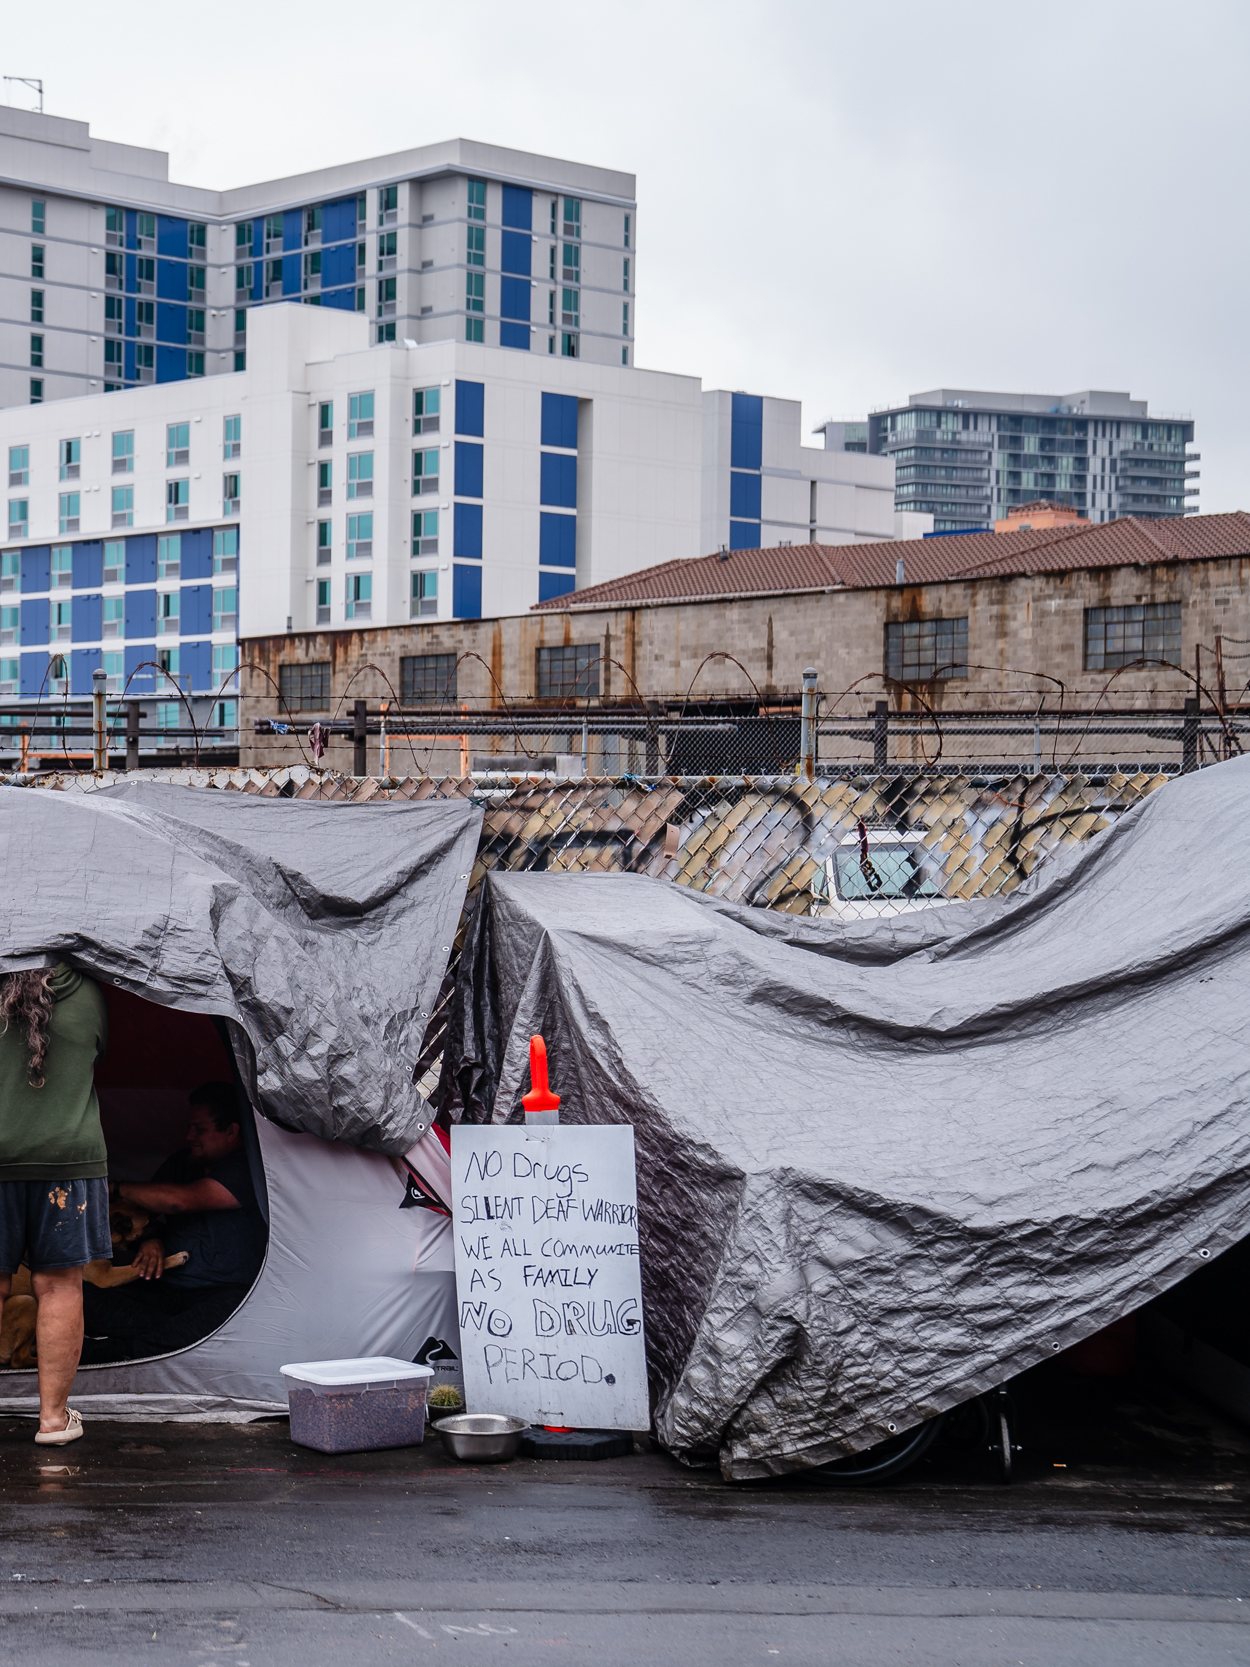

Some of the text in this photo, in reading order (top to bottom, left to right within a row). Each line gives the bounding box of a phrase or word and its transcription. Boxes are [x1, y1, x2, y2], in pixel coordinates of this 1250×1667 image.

[464, 1151, 588, 1199] NO Drugs
[460, 1195, 638, 1233] SILENT DEAF WARRIOR
[460, 1235, 492, 1261] WE
[500, 1237, 532, 1259] ALL
[470, 1264, 599, 1293] AS FAMILY
[460, 1298, 642, 1338] NO DRUG
[484, 1343, 616, 1386] PERIOD.
